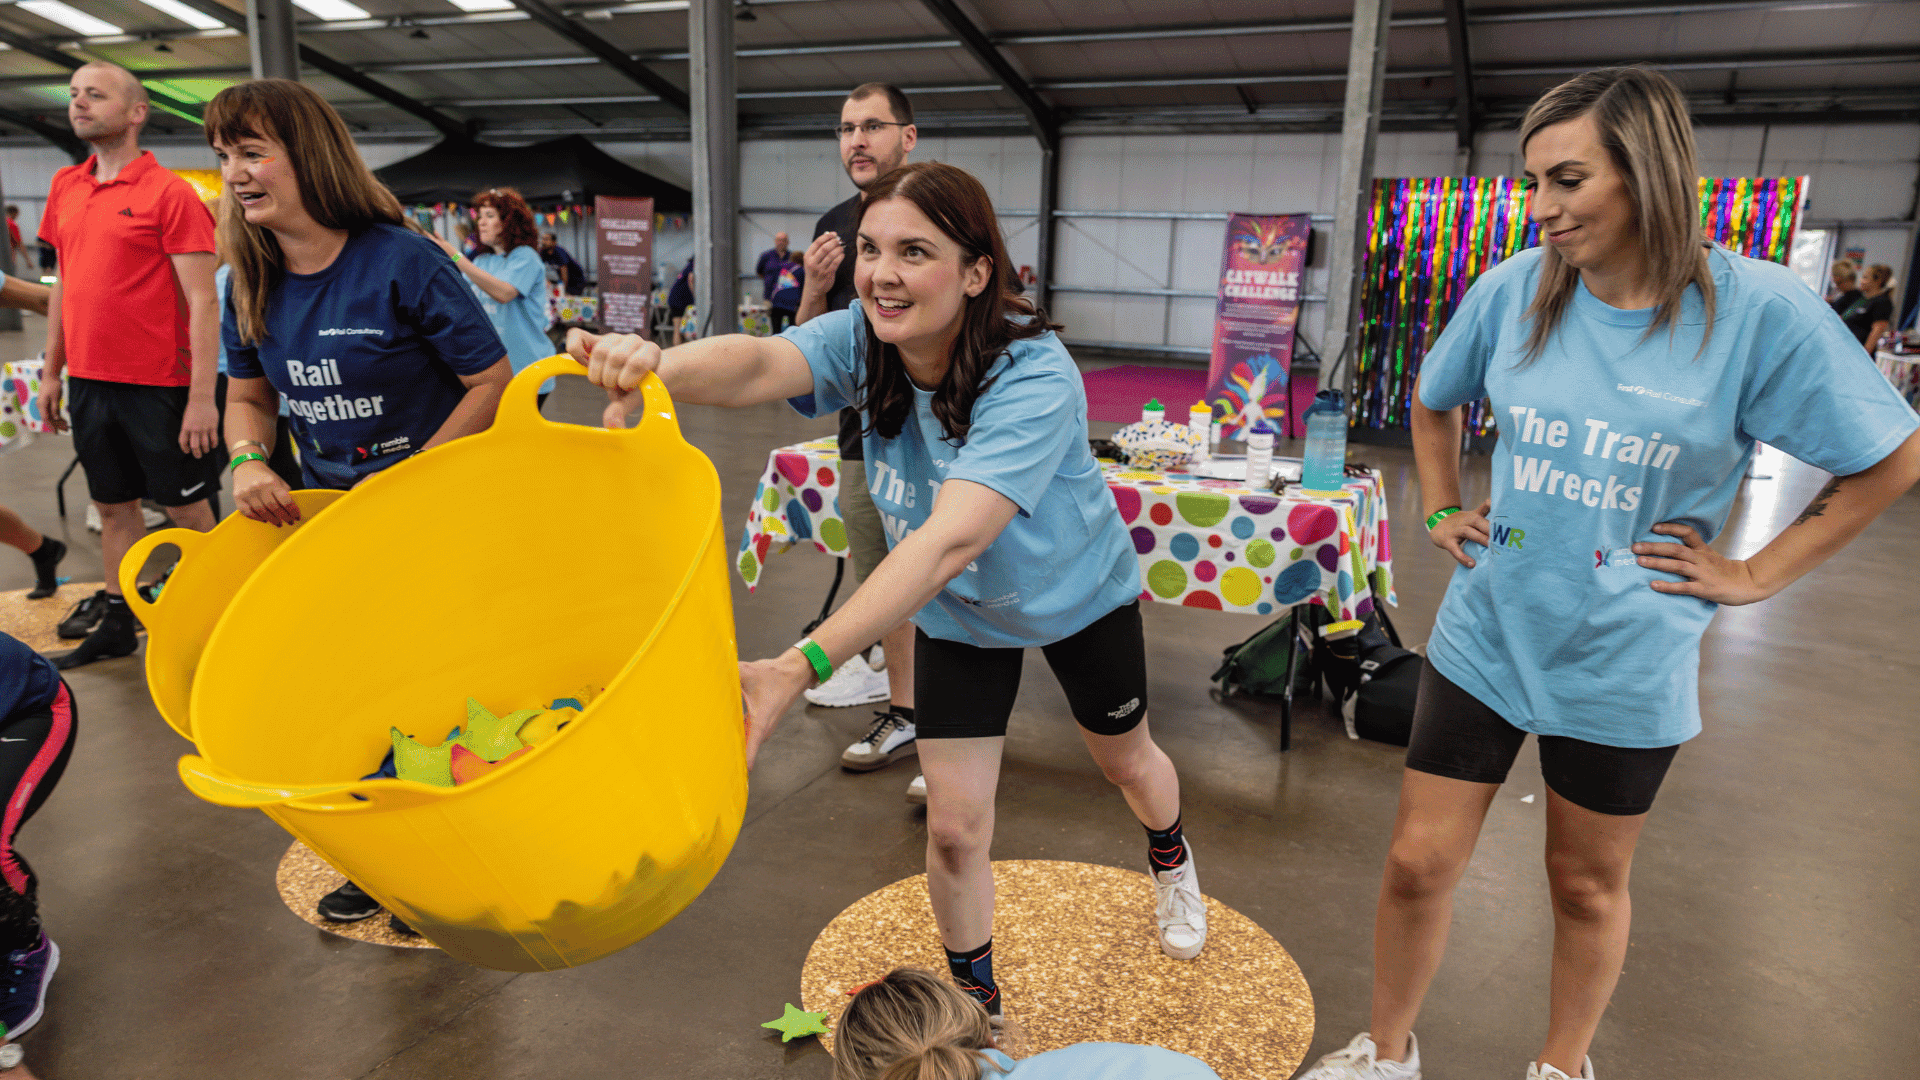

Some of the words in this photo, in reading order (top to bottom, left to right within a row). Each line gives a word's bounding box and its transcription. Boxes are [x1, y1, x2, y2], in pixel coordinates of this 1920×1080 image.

[1226, 268, 1299, 287] CATWALK
[1224, 285, 1297, 300] CHALLENGE
[286, 358, 342, 386] Rail
[380, 436, 409, 449] nimble
[1509, 405, 1569, 448] The
[1583, 418, 1681, 470] Train
[382, 444, 411, 454] media
[870, 459, 916, 508] The
[1513, 454, 1643, 512] Wrecks
[1614, 556, 1636, 566] med
